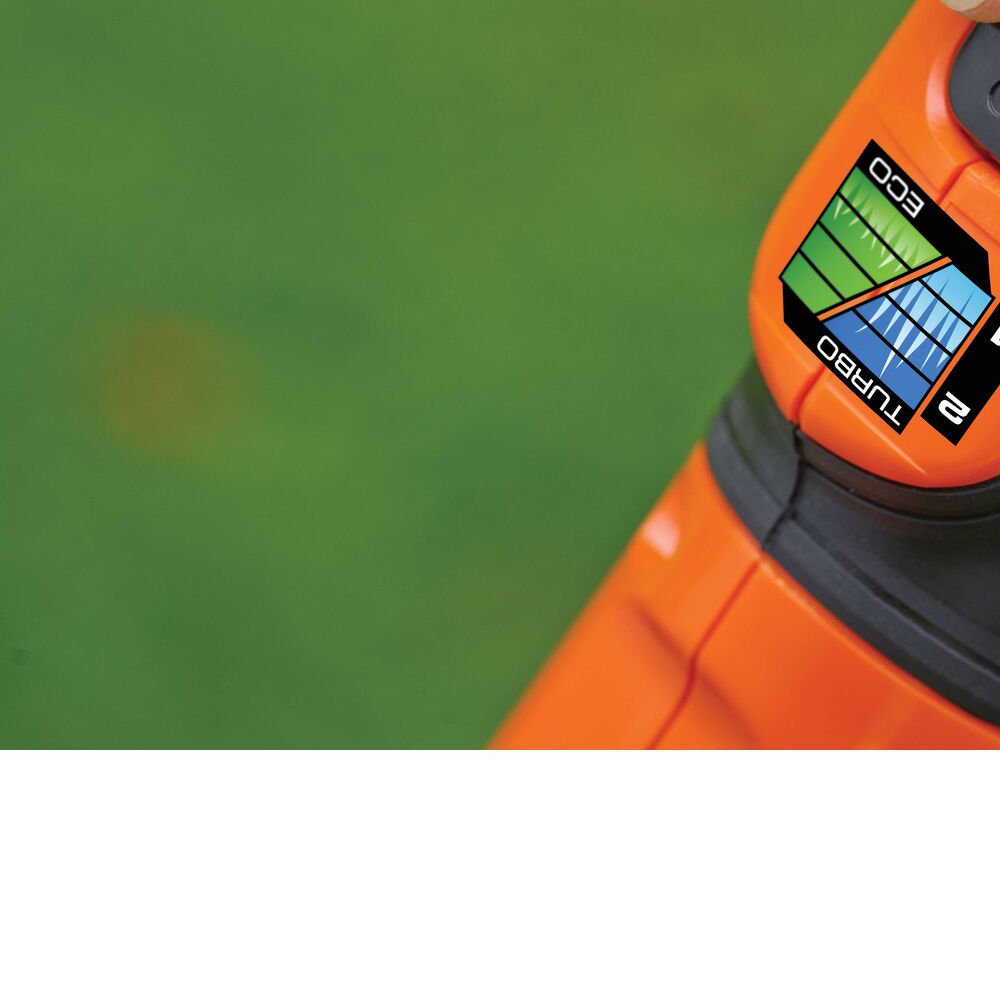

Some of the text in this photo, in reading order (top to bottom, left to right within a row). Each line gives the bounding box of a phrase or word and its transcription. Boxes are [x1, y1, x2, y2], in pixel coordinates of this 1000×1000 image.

[868, 157, 925, 219] ECO
[816, 335, 902, 427] TURBO
[938, 391, 971, 425] 2
